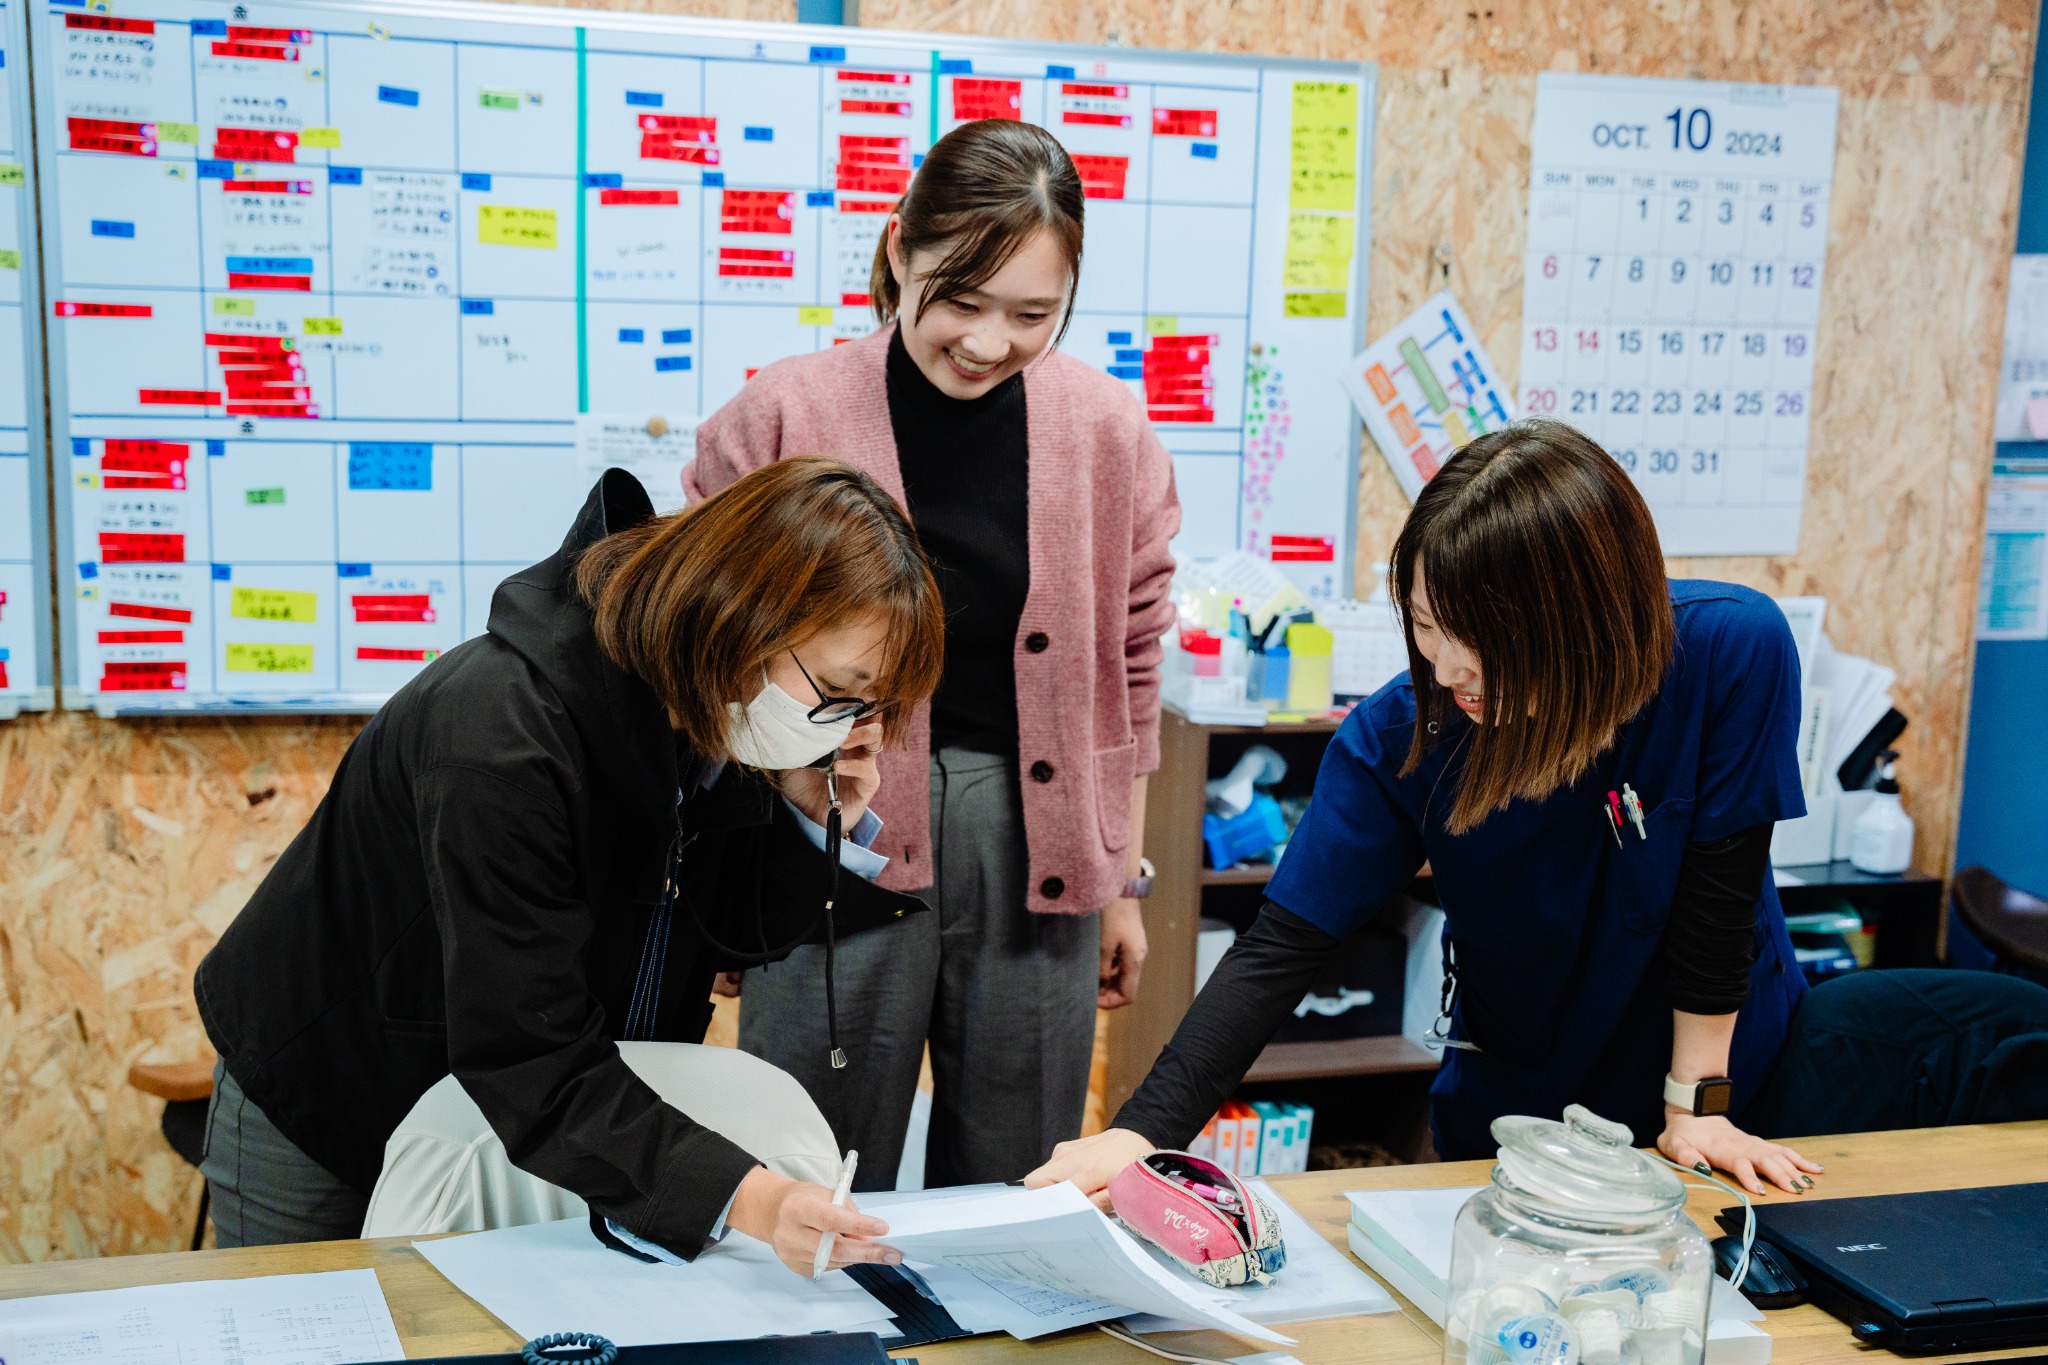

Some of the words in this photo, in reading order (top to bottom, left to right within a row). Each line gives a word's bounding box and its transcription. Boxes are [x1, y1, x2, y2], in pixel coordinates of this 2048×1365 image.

[1593, 123, 1648, 149] OCT.
[1667, 108, 1711, 150] 10
[1726, 133, 1780, 155] 2024
[1544, 172, 1570, 185] SUN
[1585, 174, 1616, 186] MON
[1632, 177, 1655, 190] TUE
[1671, 178, 1699, 190] WED
[1638, 198, 1648, 221] 1
[1677, 199, 1692, 223] 2
[1718, 201, 1734, 225] 3
[1759, 203, 1774, 225] 4
[1801, 204, 1815, 228] 5
[1543, 255, 1558, 279] 6
[1588, 257, 1601, 280] 7
[1628, 258, 1644, 282] 8
[1671, 260, 1686, 284] 9
[1708, 262, 1733, 286] 10
[1752, 265, 1773, 287] 11
[1790, 266, 1814, 288] 12
[1533, 329, 1558, 352] 13
[1575, 330, 1599, 352] 14
[1617, 331, 1641, 354] 15
[1659, 333, 1683, 355] 16
[1700, 333, 1725, 355] 17
[1743, 334, 1766, 356] 18
[1783, 335, 1806, 357] 19
[1527, 390, 1557, 413] 20
[1571, 391, 1598, 414] 21
[1611, 391, 1639, 414] 22
[1652, 392, 1681, 415] 23
[1693, 393, 1722, 415] 24
[1734, 393, 1763, 416] 25
[1775, 393, 1804, 416] 26
[1649, 451, 1679, 474] 30
[1692, 451, 1718, 474] 31
[1836, 1243, 1888, 1253] NEC
